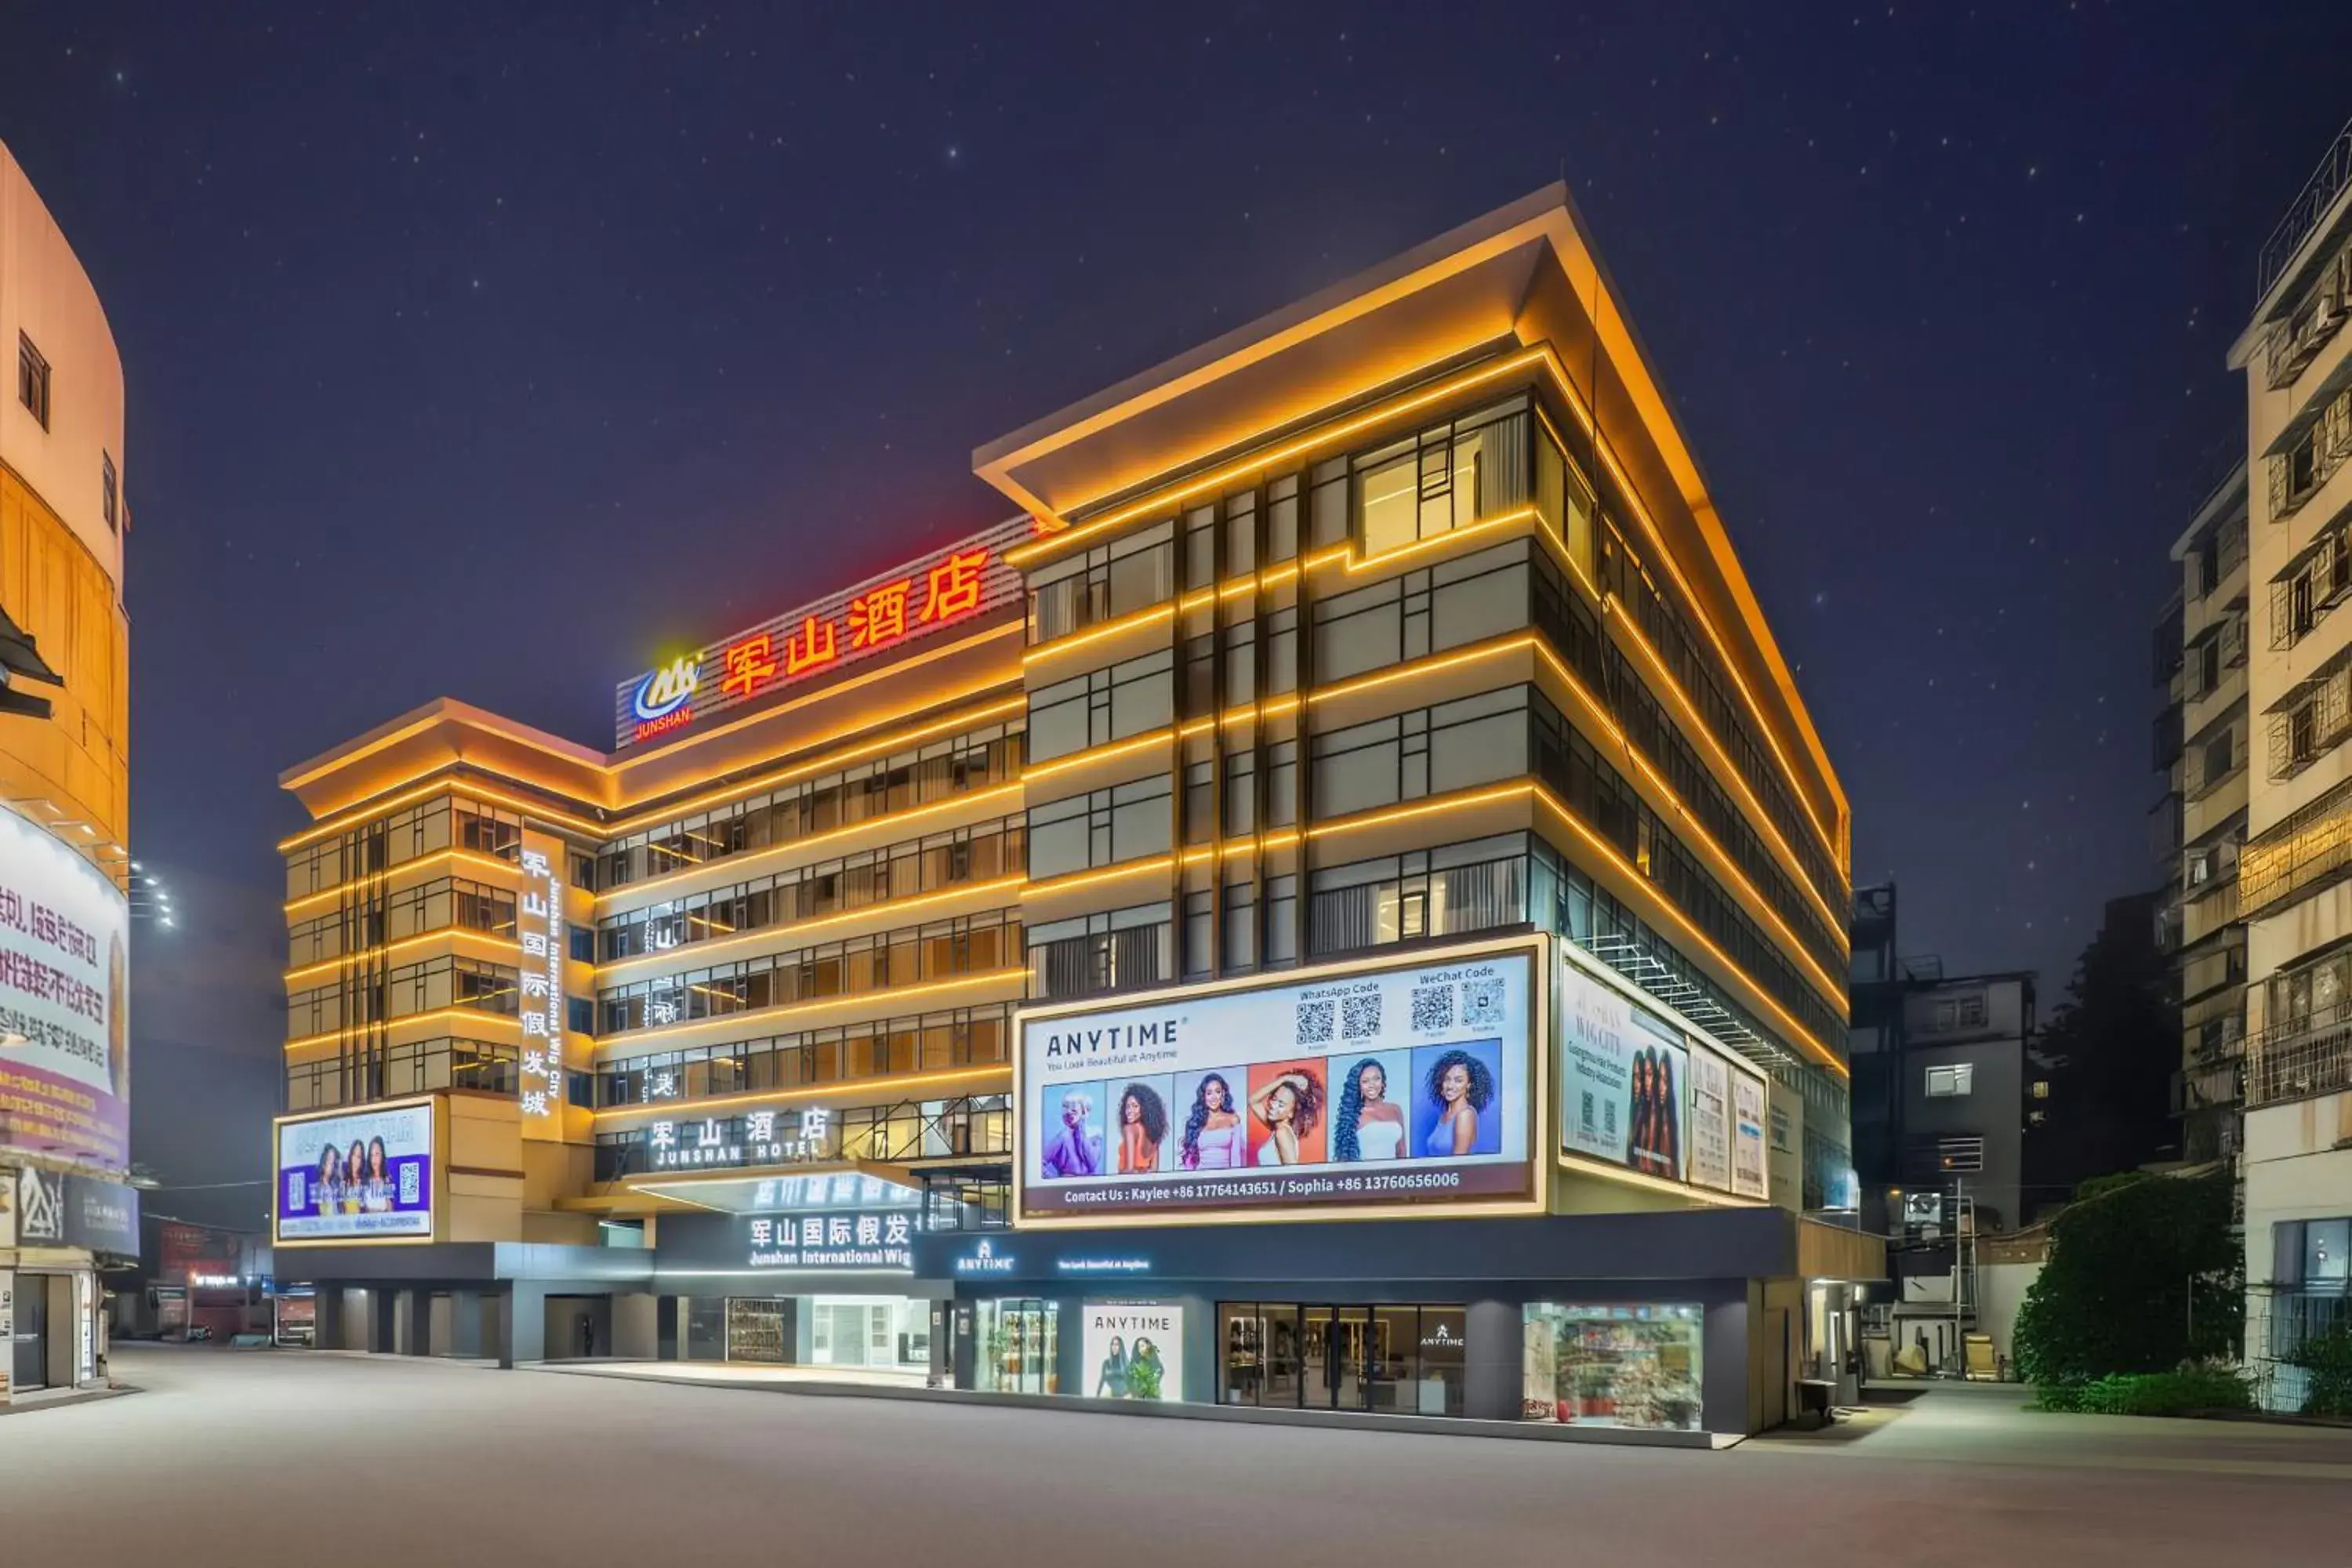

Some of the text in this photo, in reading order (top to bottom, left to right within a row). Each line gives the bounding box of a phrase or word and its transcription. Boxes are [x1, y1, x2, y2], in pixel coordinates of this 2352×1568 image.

[722, 551, 989, 694] 军山酒店
[636, 707, 690, 739] JUNSHAN
[1420, 966, 1494, 984] WeChat Code
[1299, 983, 1379, 1000] WhatsApp Code
[1047, 1020, 1177, 1057] ANYTIME
[1047, 1062, 1062, 1072] You
[1087, 1055, 1127, 1067] Beautiful
[1139, 1051, 1178, 1062] Anytime
[650, 1105, 831, 1151] 军山酒店
[657, 1138, 820, 1166] JUNSHAN HOTEL
[1065, 1189, 1106, 1203] Contact
[1131, 1187, 1170, 1203] Kaylee
[1173, 1185, 1193, 1198] +86
[1196, 1182, 1277, 1197] 17764143651
[1287, 1178, 1334, 1195] Sophia
[1337, 1177, 1361, 1190] +86
[1365, 1172, 1459, 1190] 13760656006
[750, 1250, 798, 1265] Junshan
[802, 1249, 883, 1265] International
[1095, 1316, 1170, 1330] ANYTIME
[1420, 1338, 1464, 1346] ANYTIME
